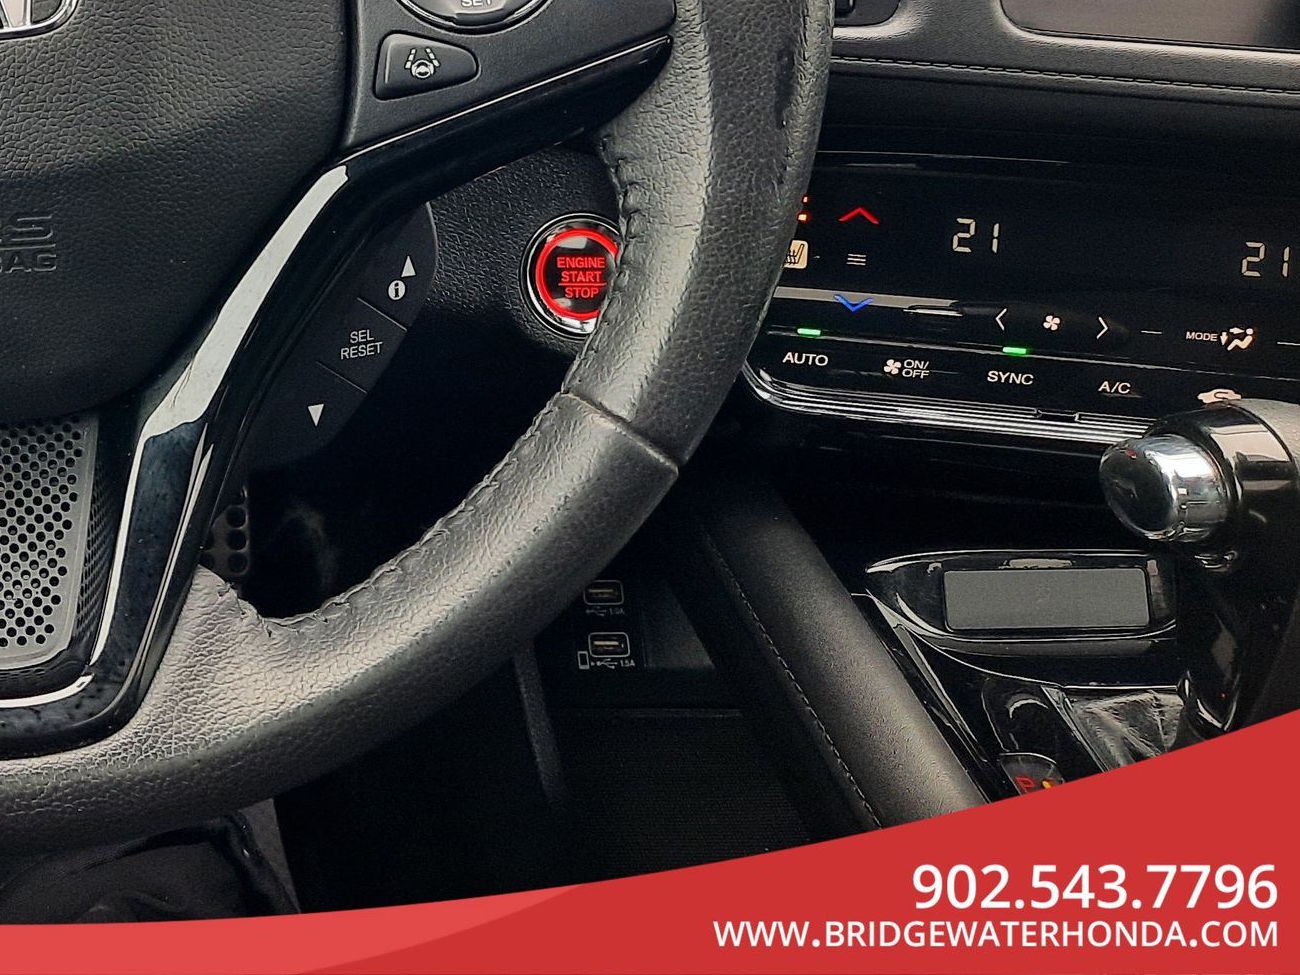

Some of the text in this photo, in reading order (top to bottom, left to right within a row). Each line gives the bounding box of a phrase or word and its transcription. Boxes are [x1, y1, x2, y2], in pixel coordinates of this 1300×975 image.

[952, 217, 1000, 253] 21
[556, 255, 606, 269] ENGINE
[1241, 241, 1290, 277] 21
[560, 270, 602, 284] START
[564, 286, 600, 300] STOP
[349, 328, 376, 343] SEL
[1185, 331, 1218, 342] MODE
[340, 341, 383, 360] RESET
[782, 351, 829, 366] AUTO
[902, 358, 930, 371] ON/
[901, 368, 931, 380] OFF
[987, 370, 1034, 385] SYNC
[1098, 380, 1131, 394] A/C
